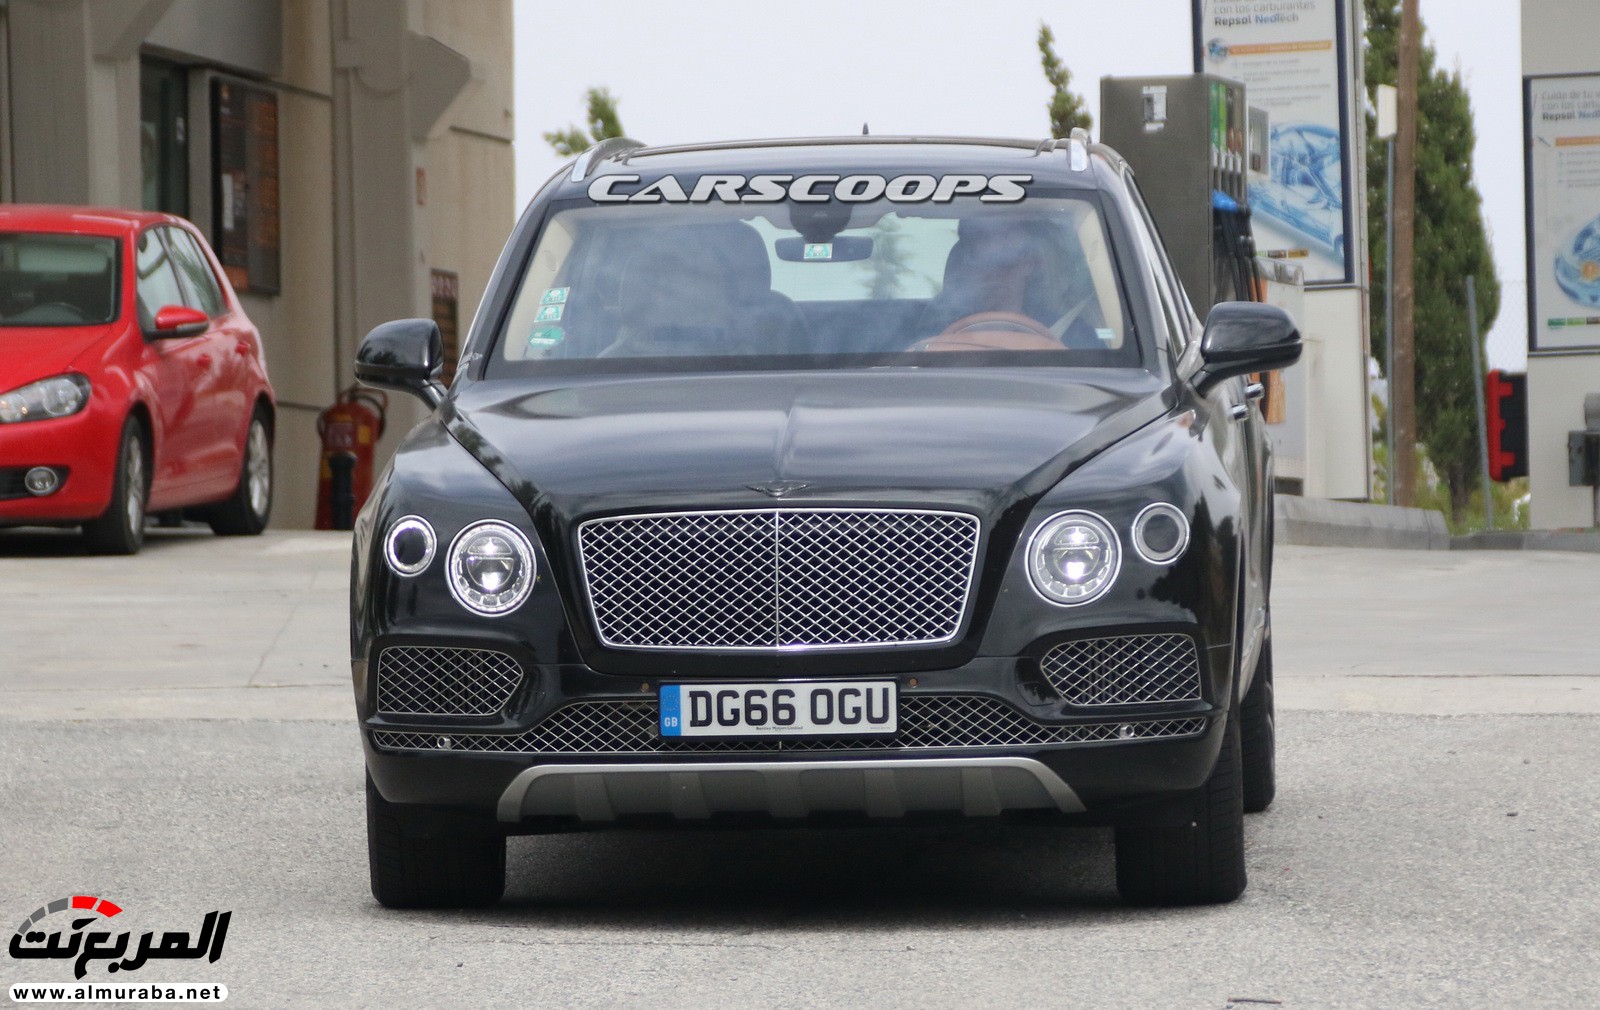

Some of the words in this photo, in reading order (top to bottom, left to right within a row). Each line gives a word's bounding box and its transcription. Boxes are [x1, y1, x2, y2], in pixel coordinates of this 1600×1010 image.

[1214, 5, 1233, 14] con
[1235, 4, 1251, 13] los
[1253, 1, 1316, 12] carburantes
[1214, 15, 1252, 27] Repsol
[1255, 12, 1299, 24] NeoTech
[1542, 111, 1576, 121] Repsol
[689, 689, 796, 727] DG66
[810, 687, 890, 725] OGU
[664, 717, 678, 728] GB
